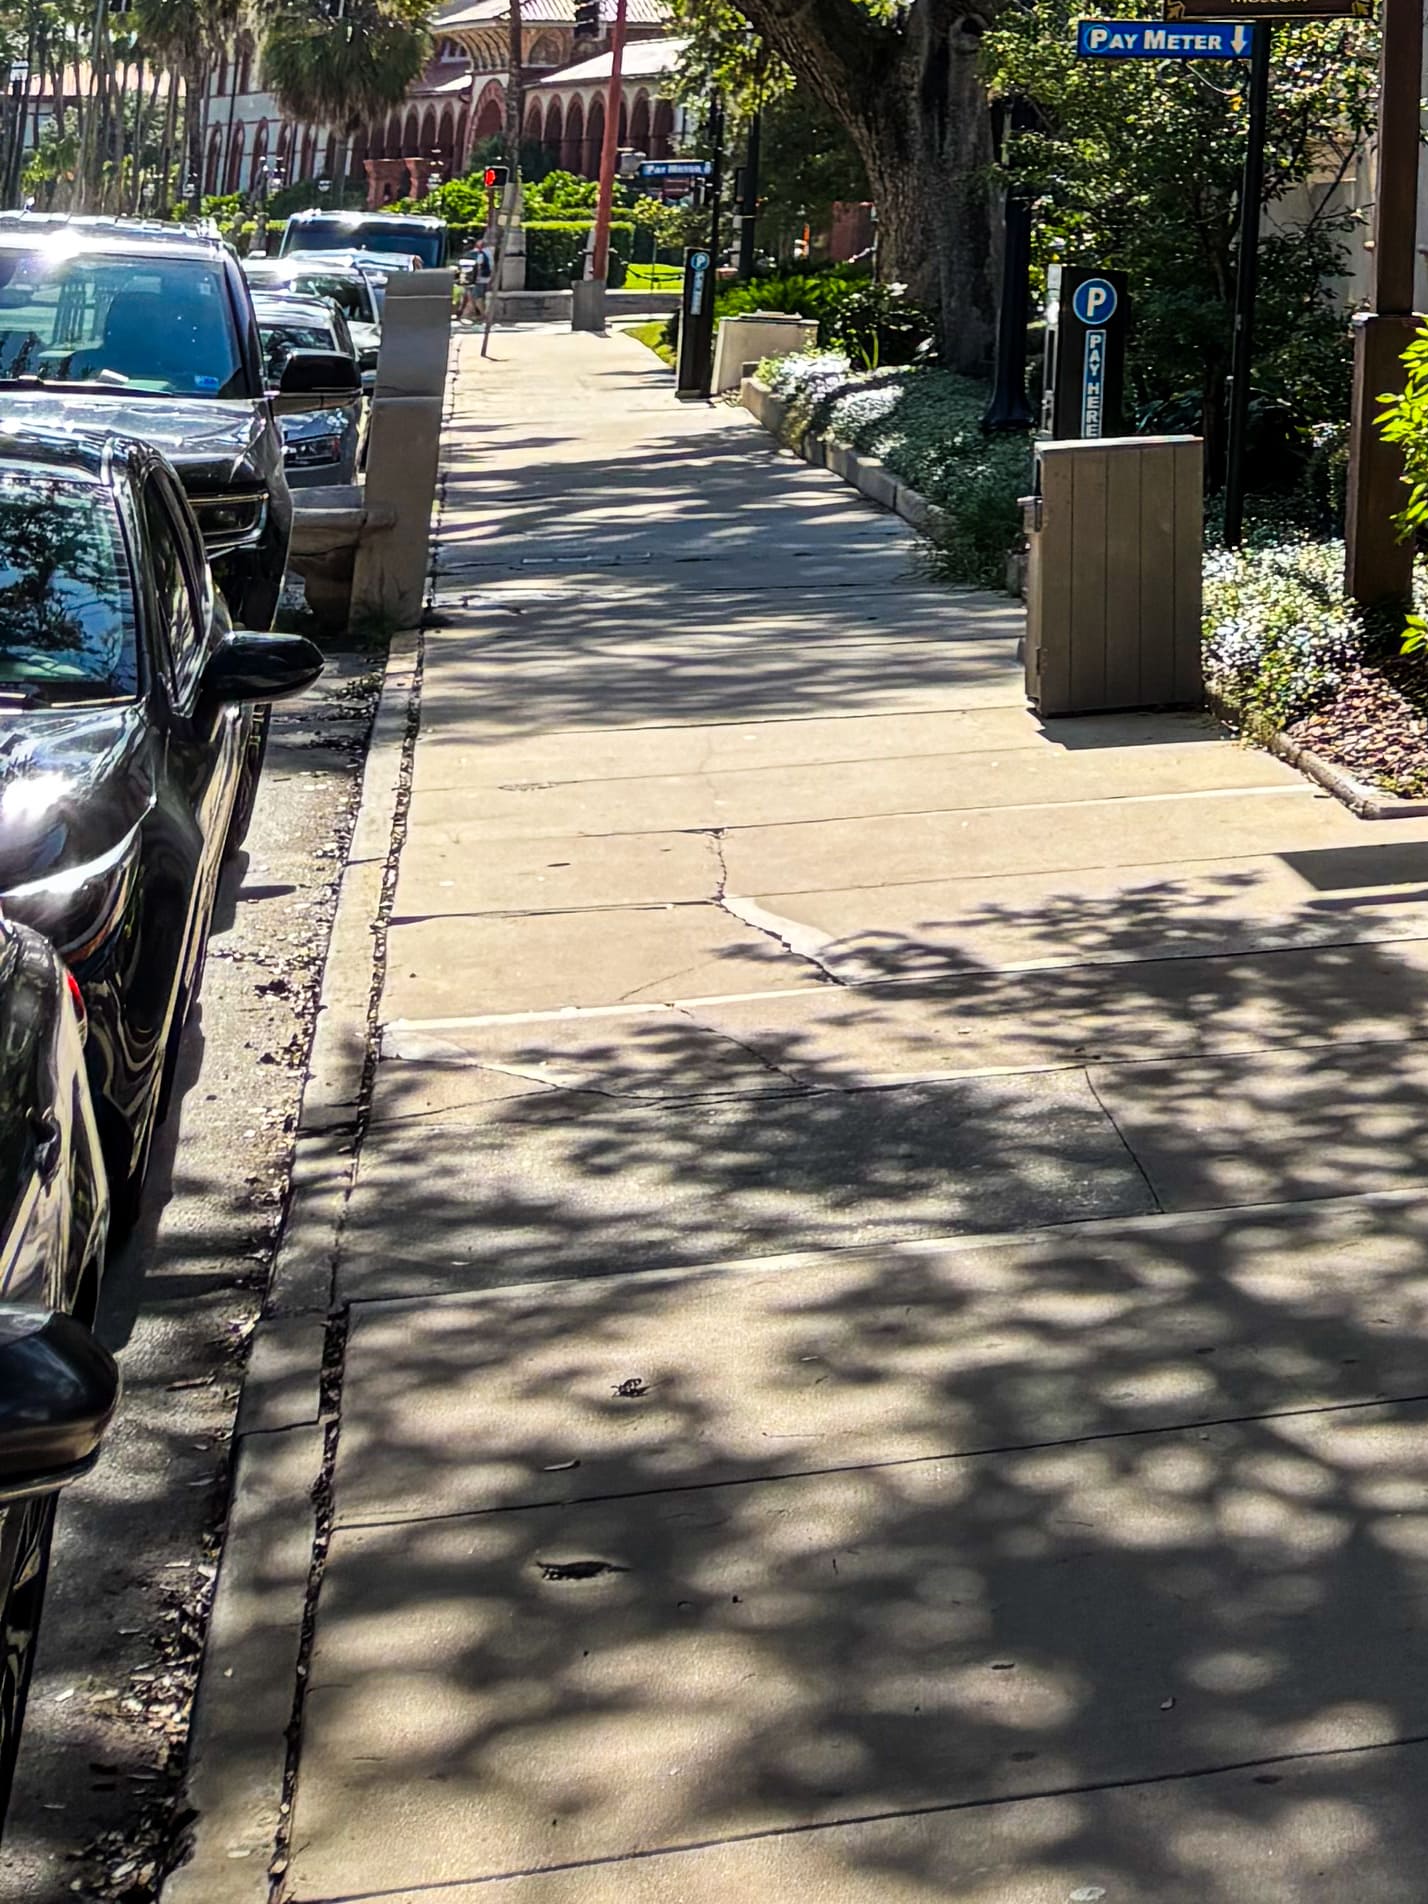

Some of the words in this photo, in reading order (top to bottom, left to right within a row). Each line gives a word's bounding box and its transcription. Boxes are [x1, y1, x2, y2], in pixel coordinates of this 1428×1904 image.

[1090, 28, 1138, 49] PAY
[1144, 29, 1222, 50] METER
[1087, 287, 1107, 317] P
[1089, 335, 1101, 377] PAY
[1086, 382, 1100, 437] HERE
